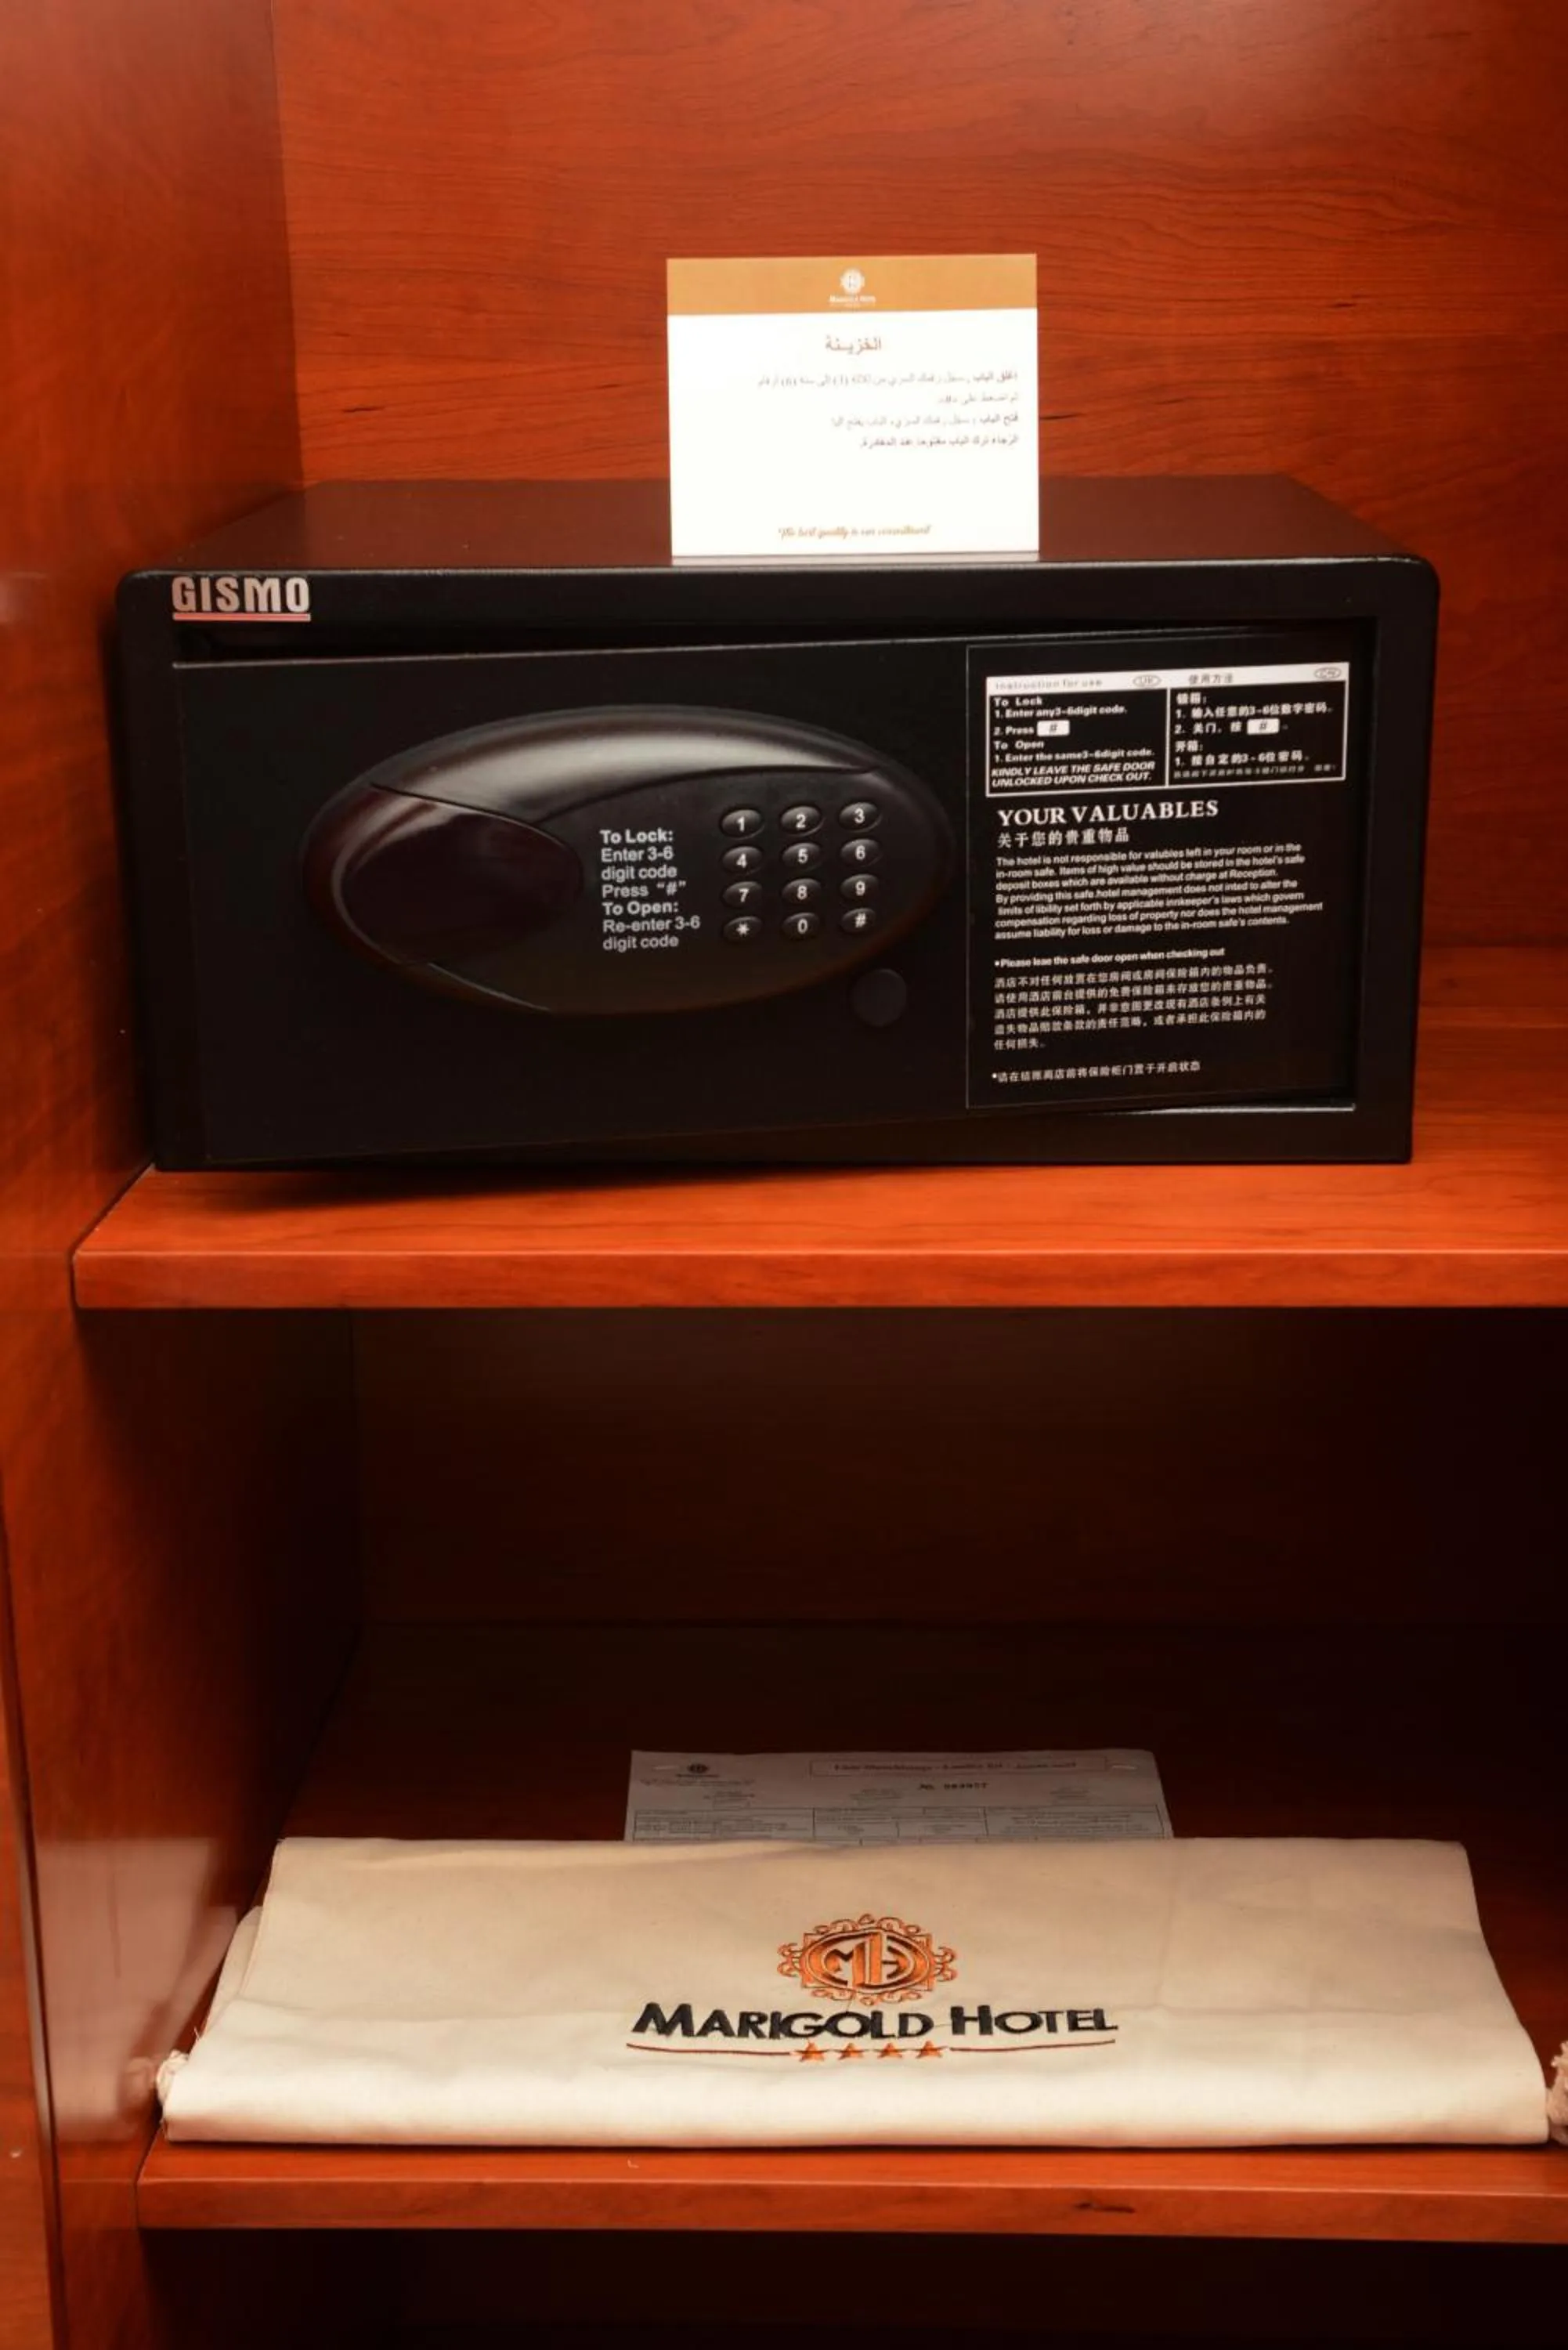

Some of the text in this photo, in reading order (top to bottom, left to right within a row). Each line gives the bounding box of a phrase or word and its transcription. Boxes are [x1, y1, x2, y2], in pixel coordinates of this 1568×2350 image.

[172, 577, 309, 613] GISMO
[994, 696, 1042, 707] To Lock
[1006, 709, 1034, 718] Enter
[1006, 726, 1034, 735] Press
[994, 741, 1044, 750] To Open
[992, 761, 1155, 777] KINDLY LEAVE THE SAFE DOOR
[992, 776, 1052, 787] UNLOCKED
[1053, 775, 1086, 785] UPON
[1088, 773, 1124, 783] CHECK
[854, 808, 864, 823] 3
[998, 799, 1219, 826] YOUR VALUABLES
[738, 818, 746, 831] 1
[797, 815, 805, 829] 2
[600, 828, 674, 844] To Lock:
[998, 827, 1129, 848] 关于您的贵重物品
[602, 846, 674, 862] Enter 3-6
[737, 854, 747, 868] 4
[798, 849, 808, 863] 5
[855, 846, 865, 860] 6
[996, 857, 1015, 866] The
[1017, 856, 1041, 866] hotel
[1071, 852, 1126, 863] responsible
[1129, 851, 1141, 859] for
[1186, 848, 1201, 857] left
[1203, 848, 1212, 856] in
[1214, 848, 1235, 857] your
[1237, 845, 1261, 854] room
[602, 865, 677, 882] digit code
[996, 870, 1032, 879] in-room
[1060, 866, 1085, 876] Items
[1098, 865, 1118, 876] high
[1121, 863, 1146, 873] value
[1148, 862, 1179, 871] should
[1181, 860, 1192, 869] be
[1194, 859, 1223, 868] stored
[1284, 855, 1306, 864] safe
[855, 882, 865, 895] 9
[996, 881, 1030, 891] deposit
[1032, 880, 1059, 888] boxes
[1062, 878, 1088, 887] which
[1107, 875, 1148, 885] available
[1150, 873, 1183, 883] without
[1185, 871, 1216, 881] charge
[1219, 870, 1227, 880] at
[602, 884, 649, 898] Press
[739, 888, 749, 902] 7
[797, 886, 807, 899] 8
[996, 894, 1008, 904] By
[1010, 891, 1053, 904] providing
[1056, 891, 1071, 900] this
[1122, 885, 1182, 898] management
[1183, 884, 1206, 893] does
[1209, 884, 1223, 892] not
[1282, 880, 1298, 888] the
[603, 901, 678, 917] To Open:
[998, 906, 1022, 915] limits
[1024, 906, 1034, 914] of
[1064, 902, 1078, 913] set
[1081, 902, 1102, 911] forth
[1104, 901, 1115, 911] by
[1117, 898, 1164, 910] applicable
[1221, 895, 1242, 903] laws
[1245, 893, 1270, 902] which
[1272, 892, 1305, 903] govern
[855, 913, 866, 927] #
[995, 916, 1060, 927] compensation
[1062, 914, 1106, 925] regarding
[1108, 912, 1127, 921] loss
[1129, 912, 1139, 920] of
[1140, 910, 1179, 921] property
[1198, 909, 1219, 917] does
[1222, 907, 1237, 916] the
[1238, 905, 1261, 915] hotel
[1263, 902, 1323, 914] management
[603, 916, 700, 933] Re-enter 3-6
[797, 920, 807, 933] 0
[995, 930, 1031, 940] assume
[1034, 927, 1065, 938] liability
[1068, 927, 1080, 936] for
[1082, 925, 1100, 935] loss
[1103, 925, 1112, 934] or
[1115, 922, 1151, 934] damage
[1154, 922, 1162, 931] to
[1165, 920, 1180, 930] the
[1181, 920, 1216, 929] in-room
[603, 935, 678, 953] digit code
[1053, 956, 1068, 965] the
[1070, 954, 1089, 964] safe
[1091, 954, 1113, 964] door
[1115, 953, 1137, 964] open
[1140, 950, 1164, 960] when
[1166, 949, 1208, 961] checking
[1209, 947, 1224, 956] out
[633, 2001, 1118, 2040] MARIGOLD HOTEL
